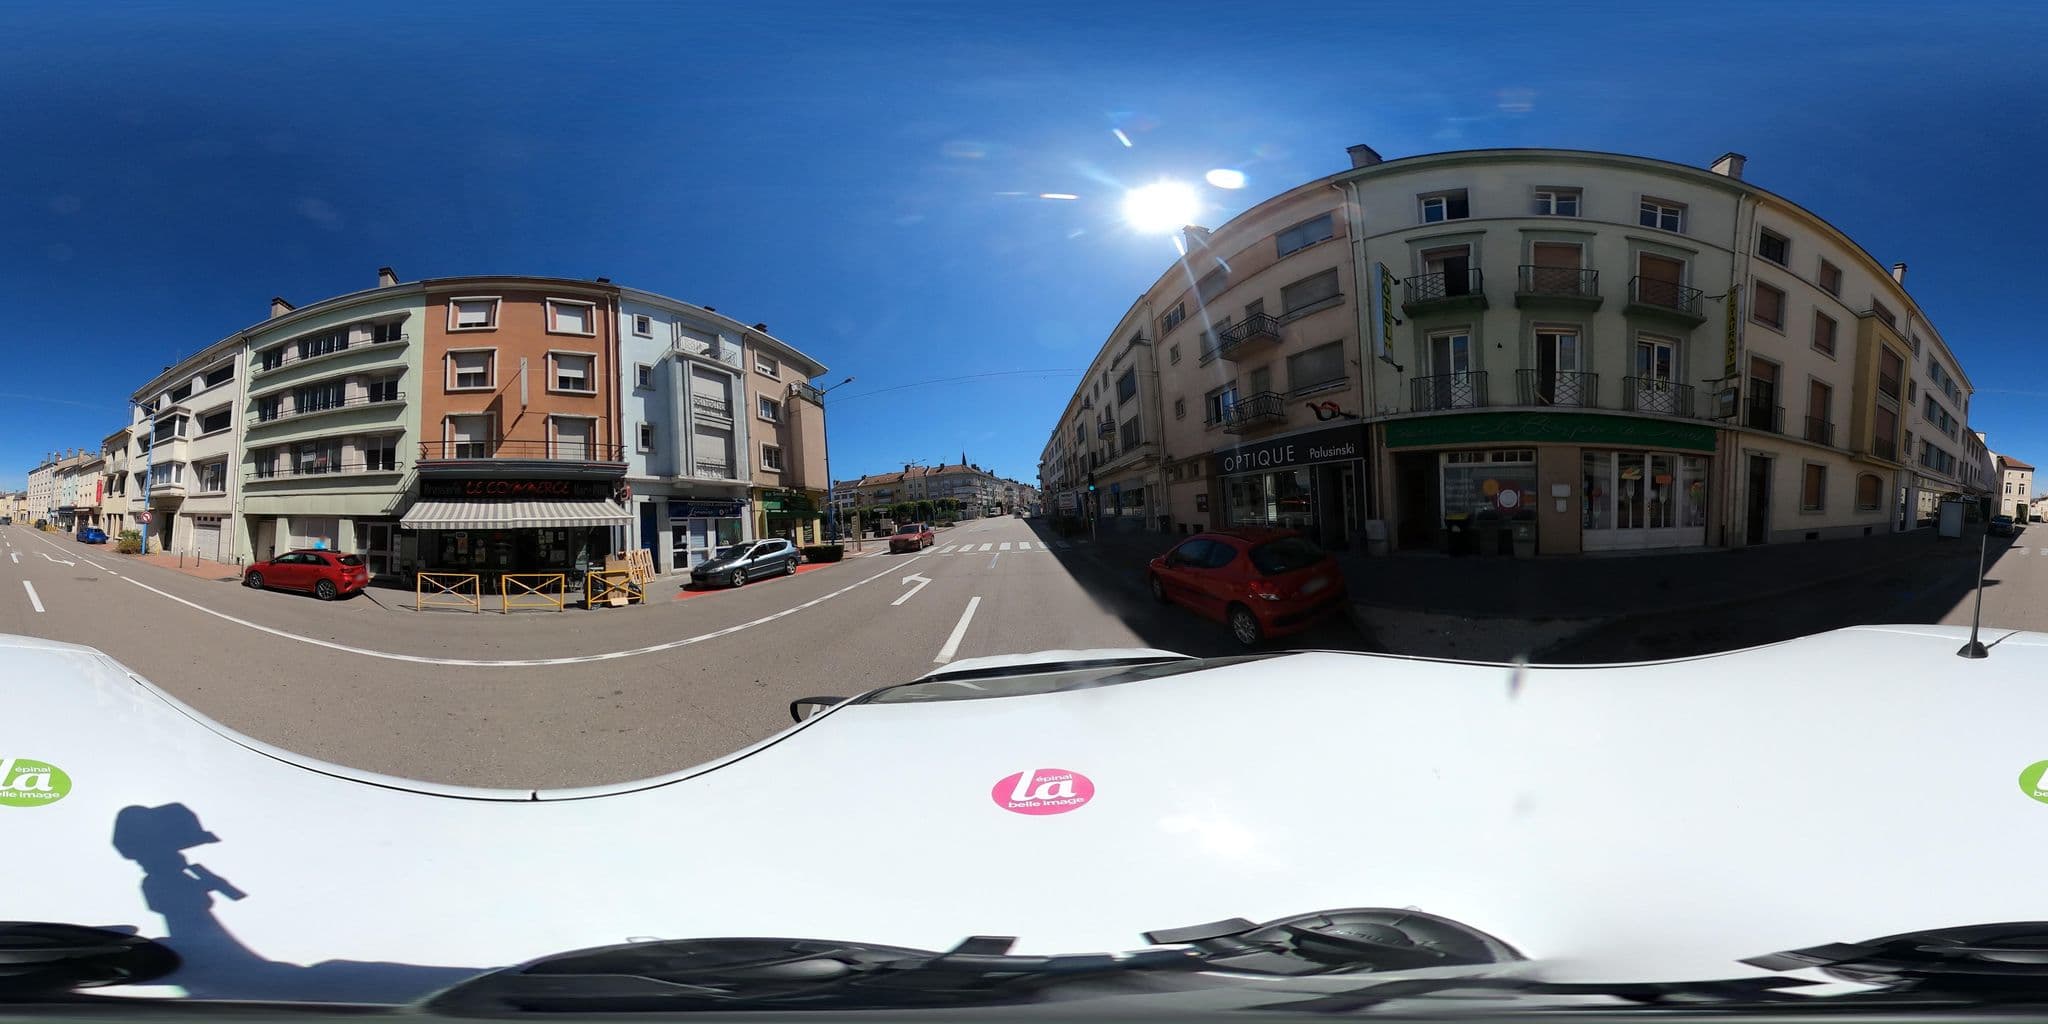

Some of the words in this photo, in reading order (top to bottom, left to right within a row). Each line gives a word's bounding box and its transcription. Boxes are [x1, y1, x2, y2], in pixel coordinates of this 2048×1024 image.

[1224, 445, 1294, 472] OPTIQUE
[1309, 442, 1355, 459] Palusinski
[19, 791, 60, 799] image
[1043, 797, 1084, 806] image
